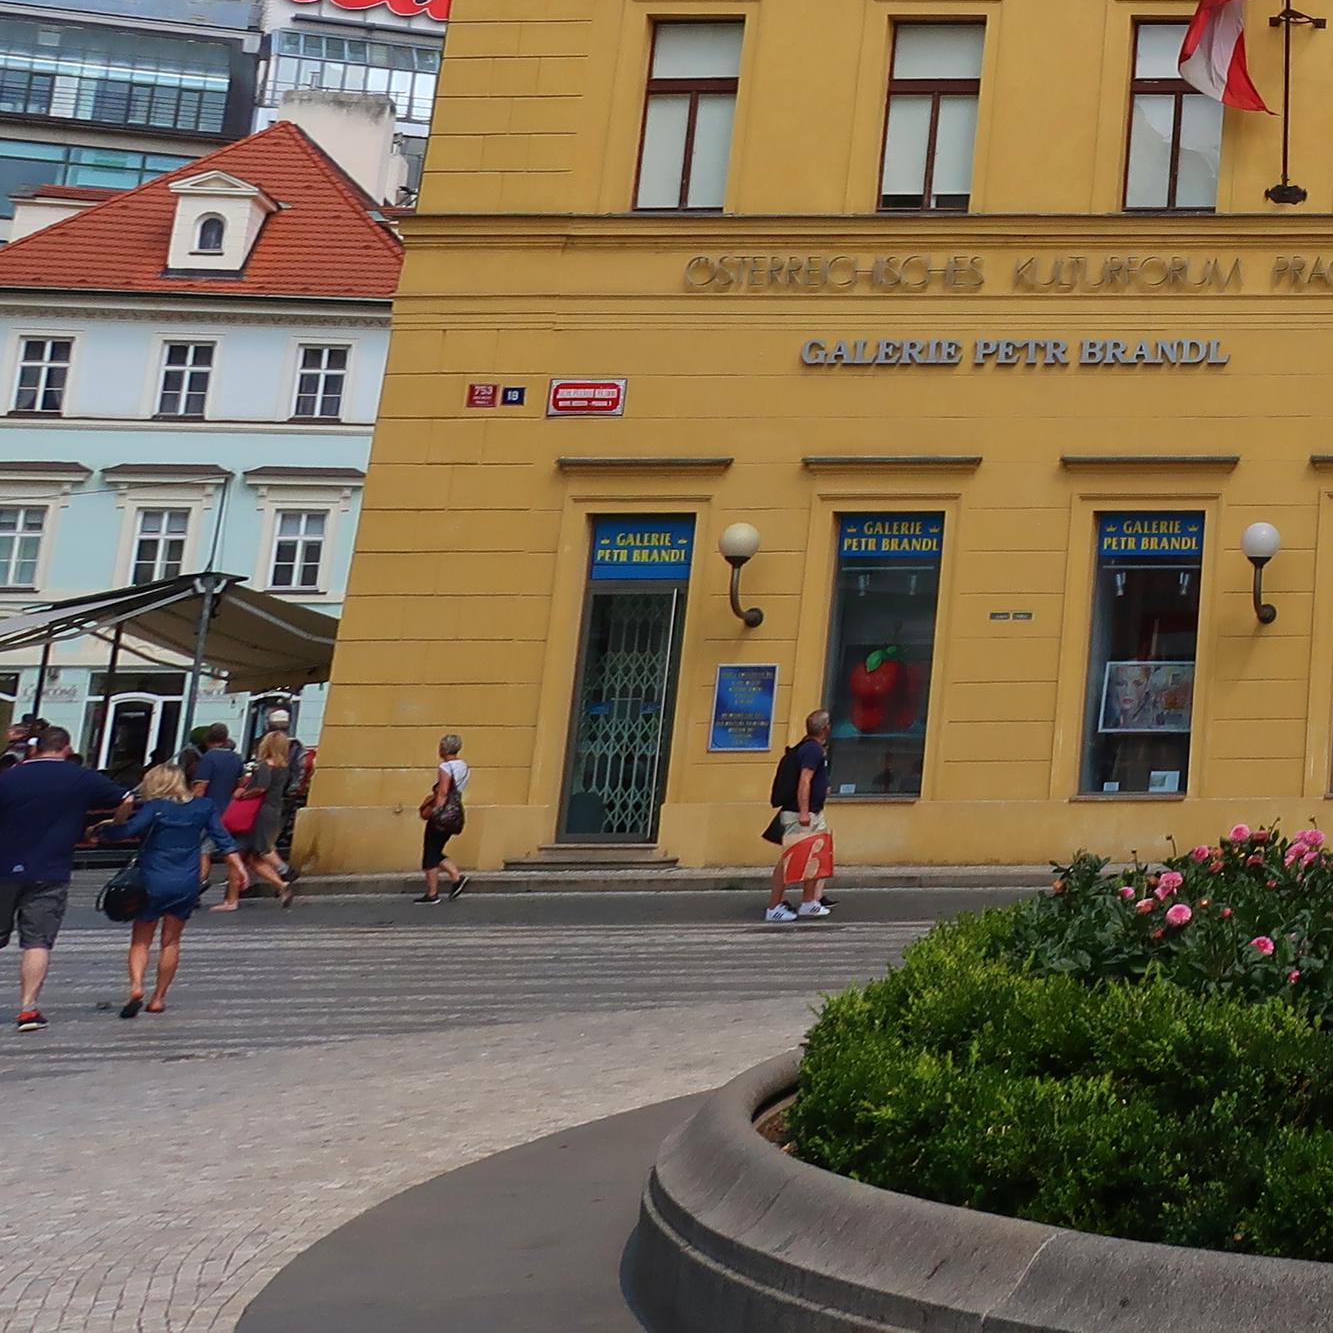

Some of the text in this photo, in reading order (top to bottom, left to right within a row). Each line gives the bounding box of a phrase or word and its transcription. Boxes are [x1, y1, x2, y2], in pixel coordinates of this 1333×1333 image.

[1013, 255, 1243, 288] KULTURFORUM
[801, 339, 1230, 364] GALERIE PETR BRANDL
[864, 521, 923, 535] GALERIE
[1123, 520, 1182, 534] GALERIE
[616, 532, 672, 546] GALERIE
[843, 538, 939, 551] PETR BRANDL
[1103, 537, 1198, 550] PETR BRANDL
[597, 549, 628, 562] PETR
